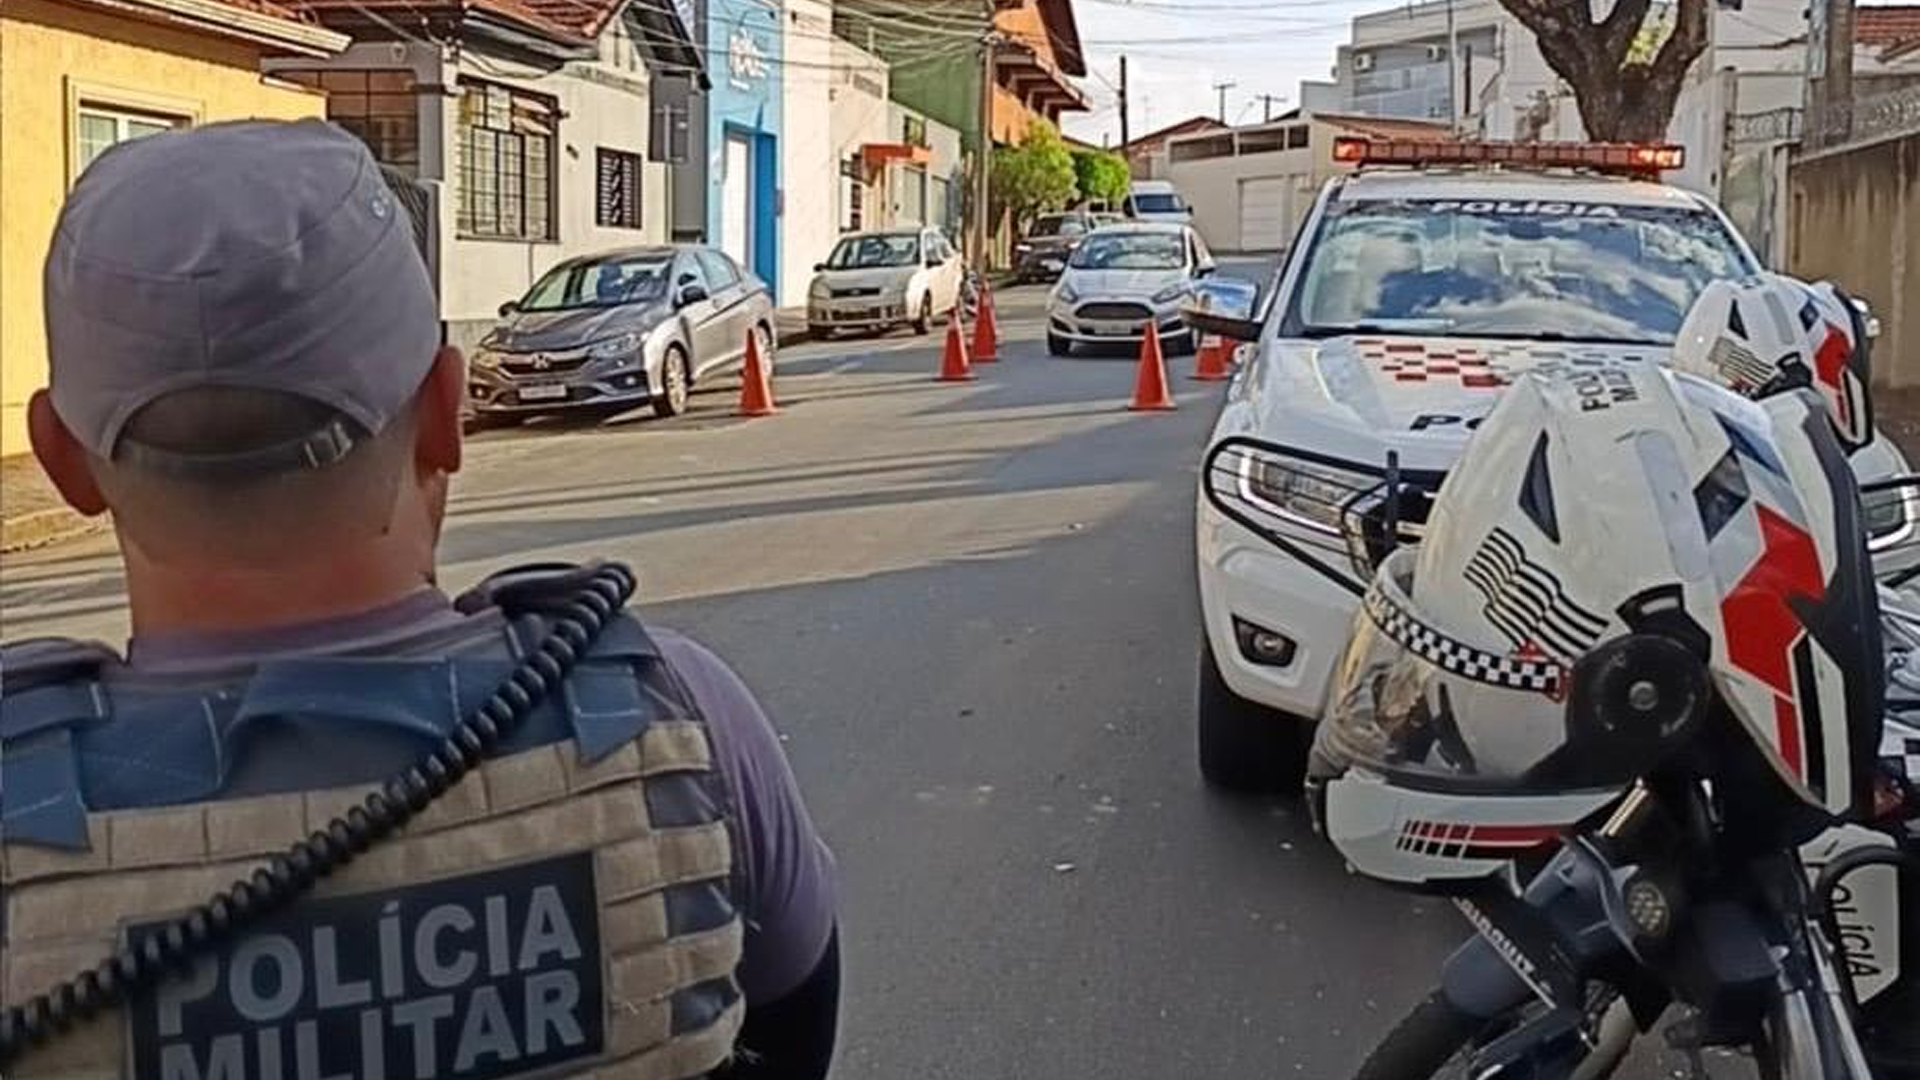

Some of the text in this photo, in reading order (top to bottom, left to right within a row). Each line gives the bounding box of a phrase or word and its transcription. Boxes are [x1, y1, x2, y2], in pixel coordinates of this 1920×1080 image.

[158, 884, 582, 1037] POLÍCIA
[1831, 884, 1883, 978] OLÍCIA
[160, 969, 585, 1080] MILITAR
